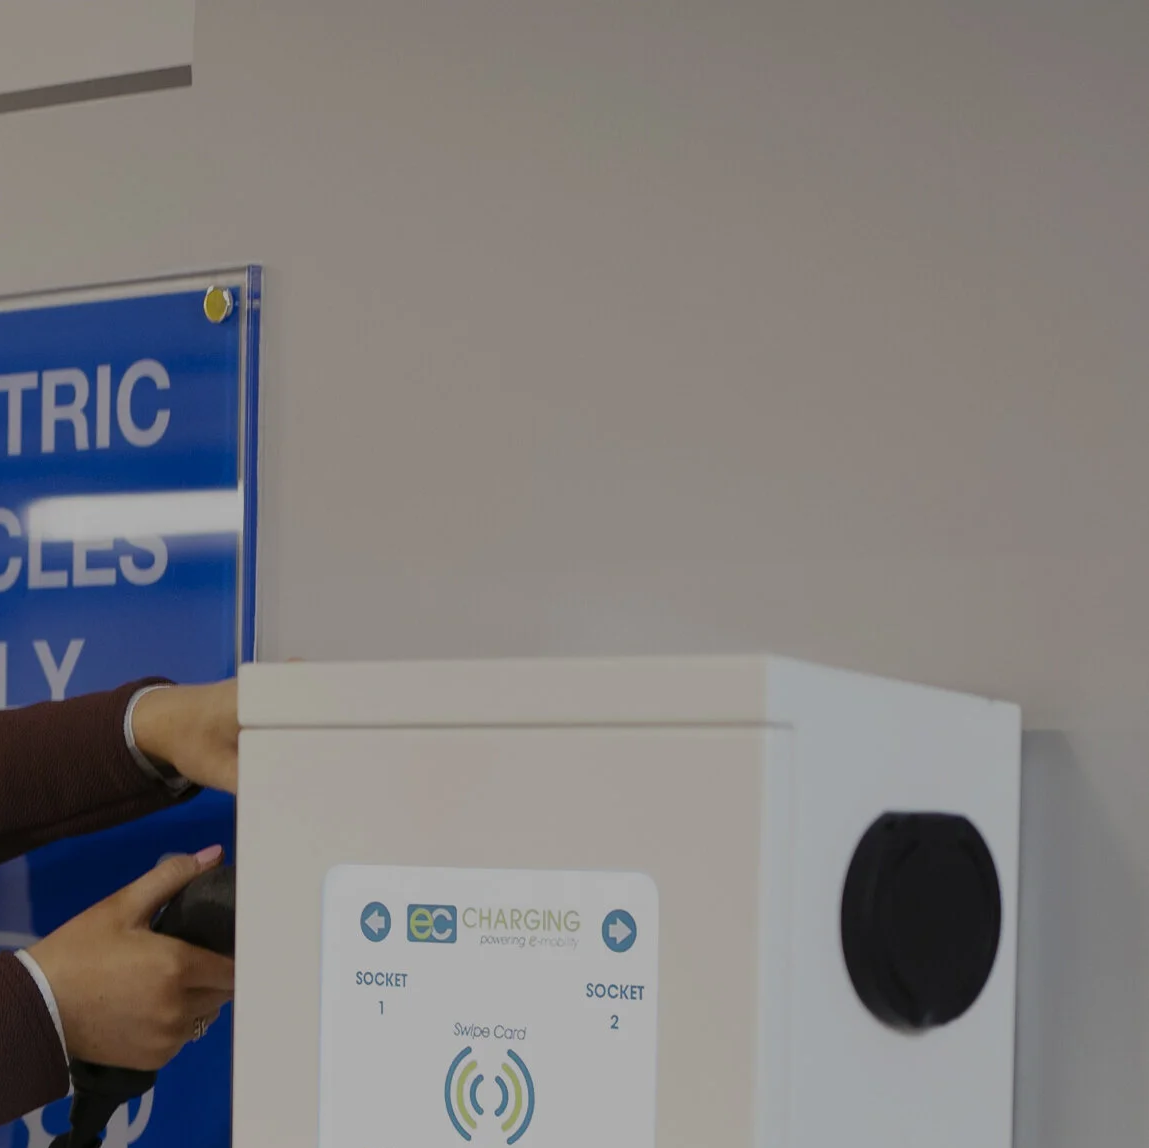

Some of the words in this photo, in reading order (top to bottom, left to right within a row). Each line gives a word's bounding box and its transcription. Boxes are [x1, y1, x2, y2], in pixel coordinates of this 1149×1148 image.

[462, 907, 581, 932] CHARGING
[480, 934, 526, 948] powering
[355, 971, 408, 988] SOCKET
[586, 983, 645, 1000] SOCKET
[378, 1001, 384, 1015] 1
[610, 1015, 619, 1030] 2
[453, 1023, 490, 1039] Swipe
[493, 1025, 527, 1041] Card
